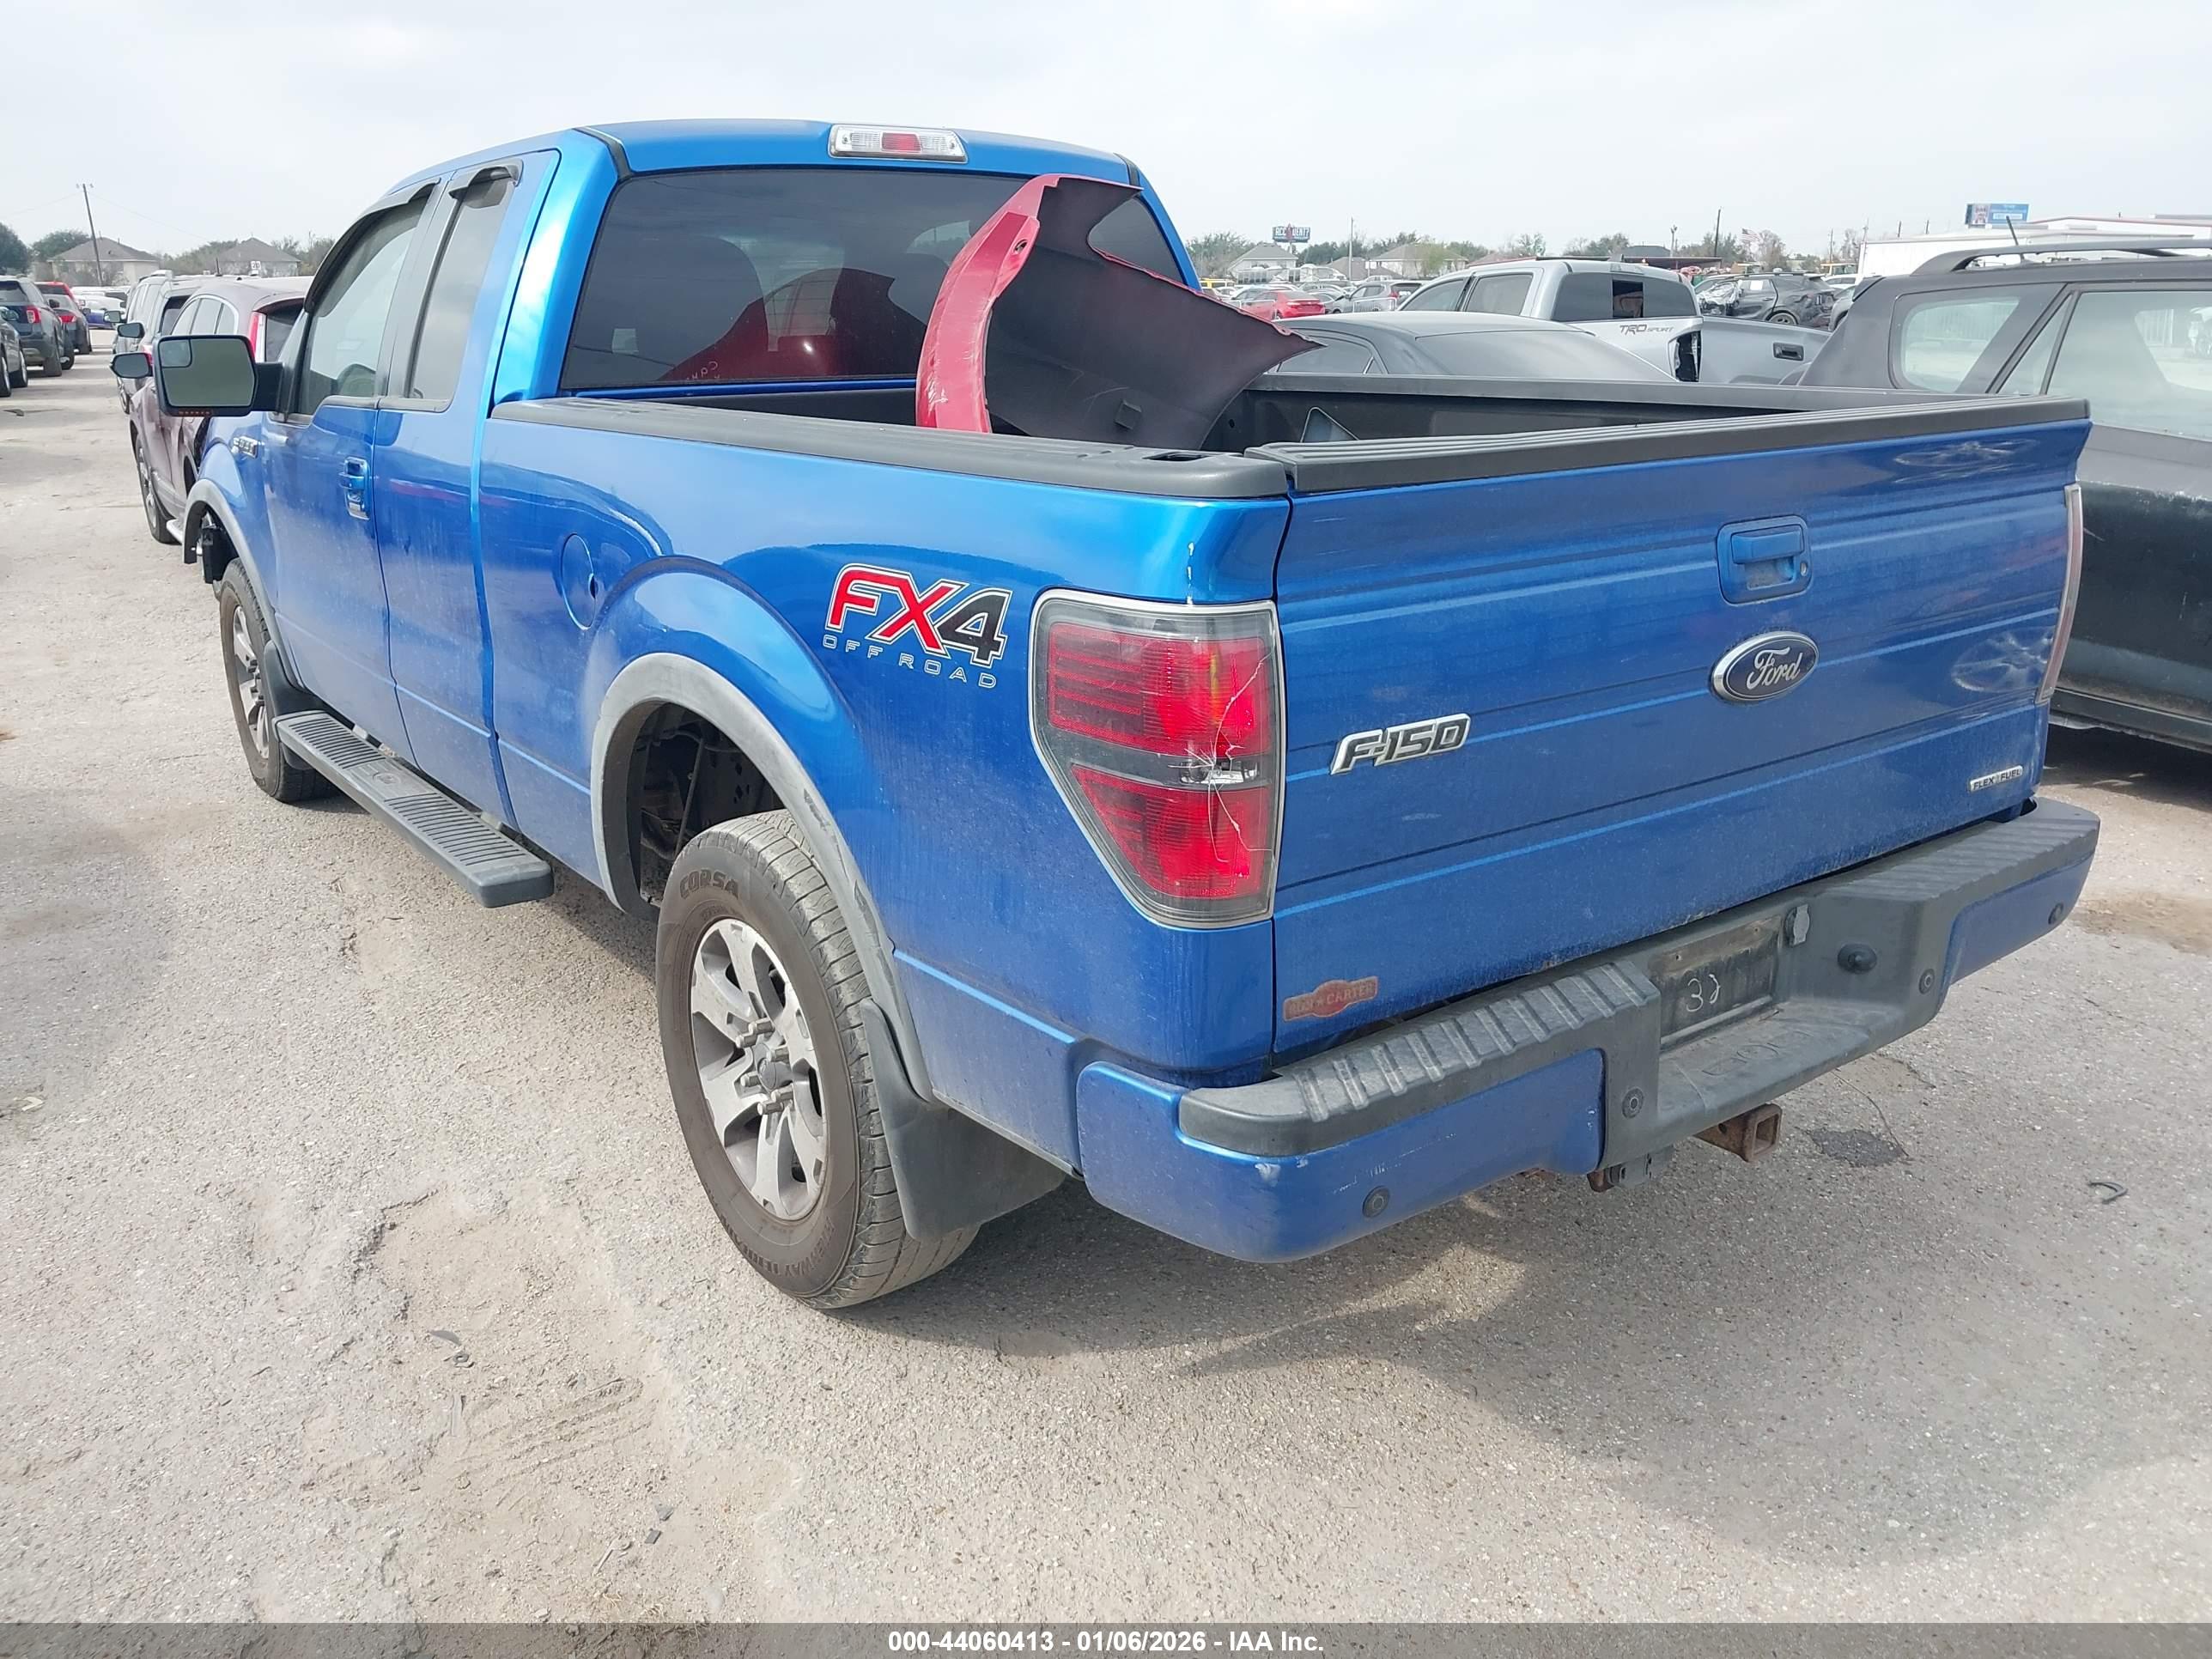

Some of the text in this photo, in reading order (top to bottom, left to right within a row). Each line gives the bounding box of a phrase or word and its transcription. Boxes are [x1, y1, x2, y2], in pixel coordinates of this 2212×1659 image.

[1274, 226, 1310, 236] ACCDENT?
[1620, 324, 1648, 336] TRD
[825, 563, 1013, 668] FX4
[823, 634, 997, 690] OFF ROAD
[1746, 647, 1803, 690] Ford
[1330, 713, 1471, 775] F-150
[1972, 769, 2021, 790] FLEX FUEL
[679, 868, 739, 901] CORSA
